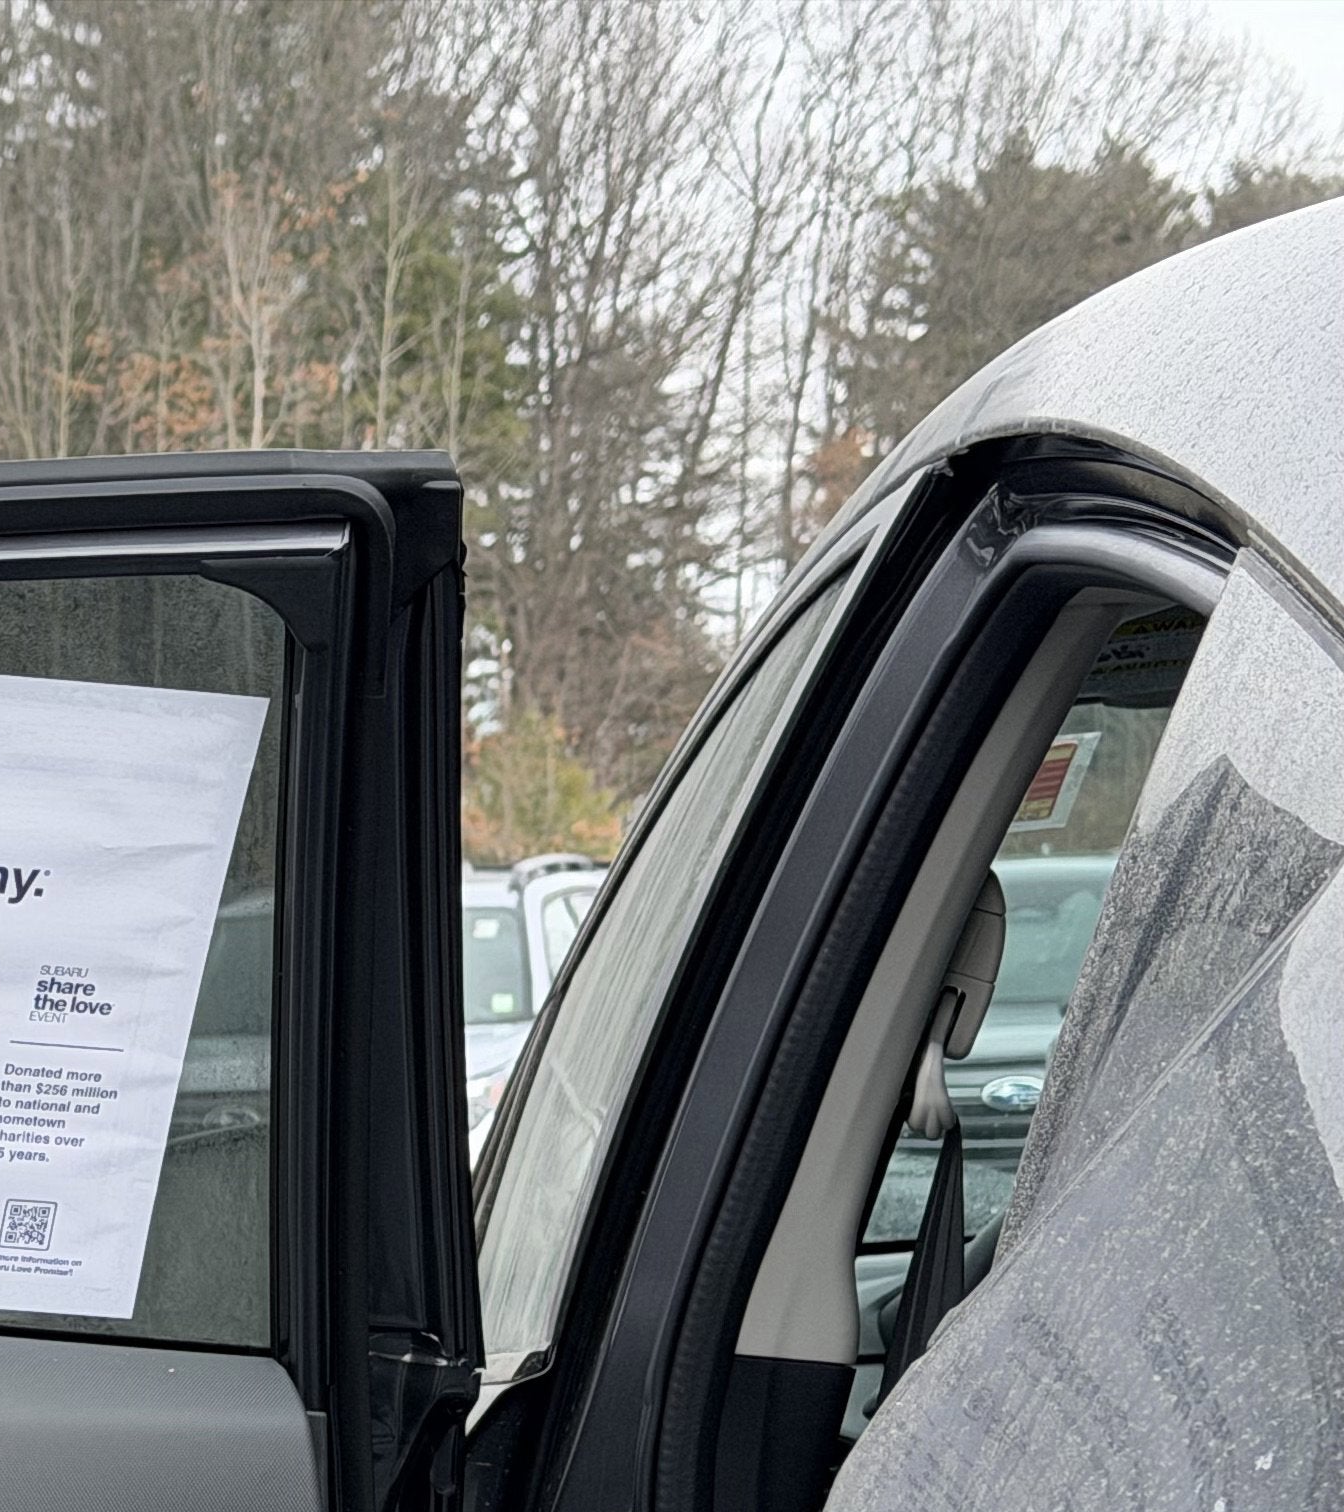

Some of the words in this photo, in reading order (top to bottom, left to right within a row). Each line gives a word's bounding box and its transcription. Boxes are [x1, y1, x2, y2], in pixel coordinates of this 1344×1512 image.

[39, 964, 90, 979] SUBARU
[35, 976, 96, 997] share
[33, 993, 68, 1013] the
[69, 995, 113, 1016] love
[28, 1010, 69, 1024] EVENT
[3, 1062, 64, 1080] Donated
[65, 1070, 103, 1083] more
[0, 1079, 32, 1094] than
[35, 1081, 69, 1097] $256
[70, 1086, 118, 1100] million
[14, 1098, 72, 1113] national
[73, 1102, 101, 1115] and
[54, 1135, 86, 1148] over
[8, 1149, 50, 1163] years.
